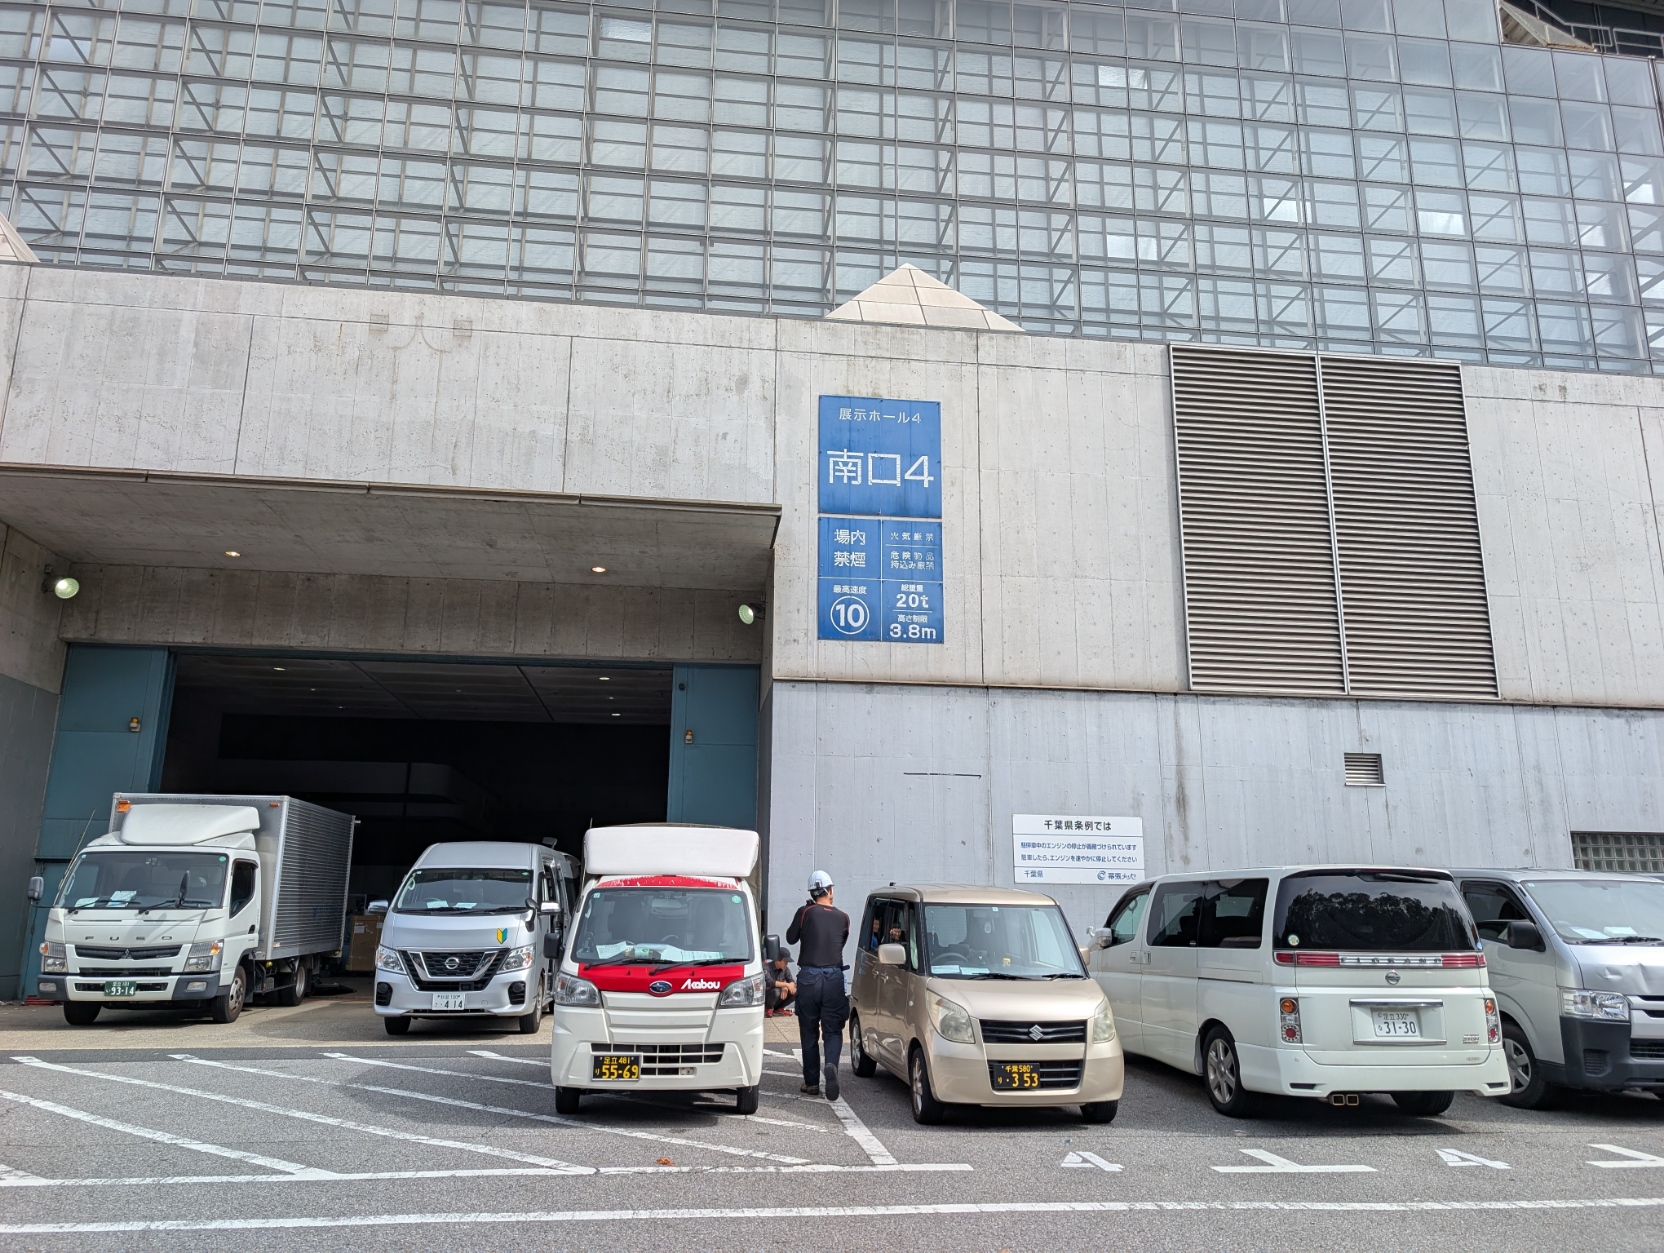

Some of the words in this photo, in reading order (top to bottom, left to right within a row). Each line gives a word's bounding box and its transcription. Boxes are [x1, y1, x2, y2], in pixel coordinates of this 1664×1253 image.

[839, 408, 922, 424] 展示ホール4
[827, 448, 934, 488] 南口4
[834, 529, 866, 546] 場内
[890, 532, 934, 542] 火気厳禁
[834, 551, 866, 567] 禁煙
[890, 550, 934, 560] 危険物品
[890, 560, 934, 570] 持込み厳禁
[833, 585, 867, 594] 最高速度
[900, 584, 924, 593] 総重量
[896, 594, 929, 608] 20t
[836, 604, 865, 627] 10
[898, 614, 928, 624] 高さ制限
[890, 623, 936, 639] 3.8m
[1044, 820, 1112, 831] 千葉県条例では
[1024, 870, 1044, 878] 千葉県
[1108, 872, 1137, 880] 幕張メッセ
[681, 979, 720, 989] Akabou
[111, 986, 134, 995] 93-14
[1384, 1021, 1416, 1034] 31-30
[602, 1065, 639, 1079] 55-69
